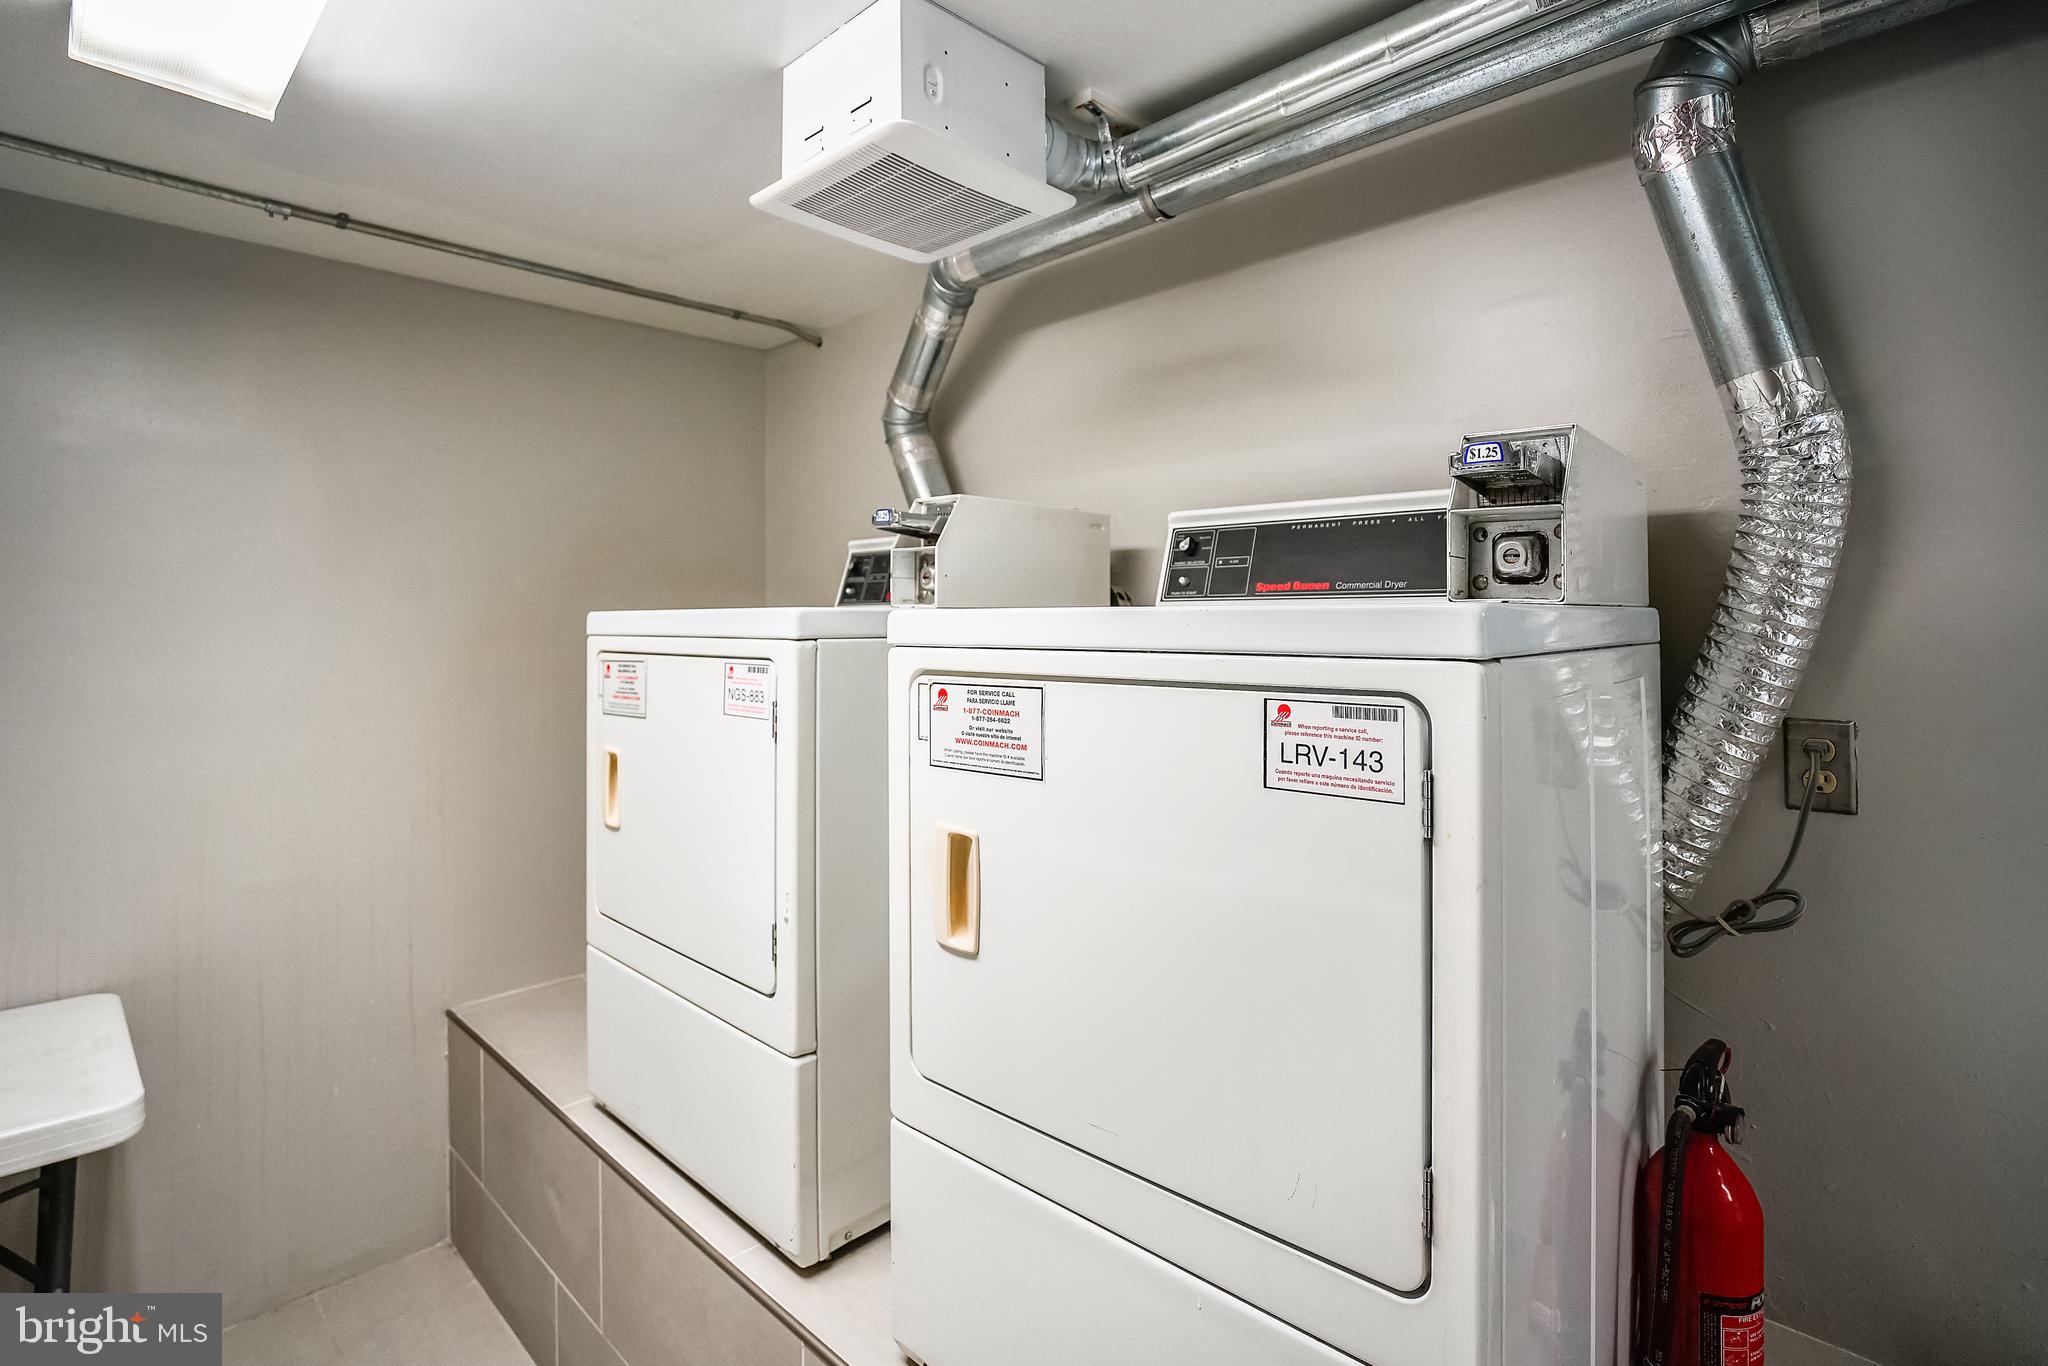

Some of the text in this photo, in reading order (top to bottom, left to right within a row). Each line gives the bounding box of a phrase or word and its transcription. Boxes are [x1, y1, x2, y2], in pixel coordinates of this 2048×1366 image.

[1470, 447, 1498, 460] $1.25
[1292, 522, 1342, 530] PERMANENT
[1255, 580, 1407, 592] Speed Queen Commercial Dryer
[963, 708, 1020, 717] 1-877-COINMACH
[955, 737, 1027, 751] WWW.COINMACH.COM
[1281, 742, 1384, 773] LRV-143
[1343, 776, 1375, 784] necesitando
